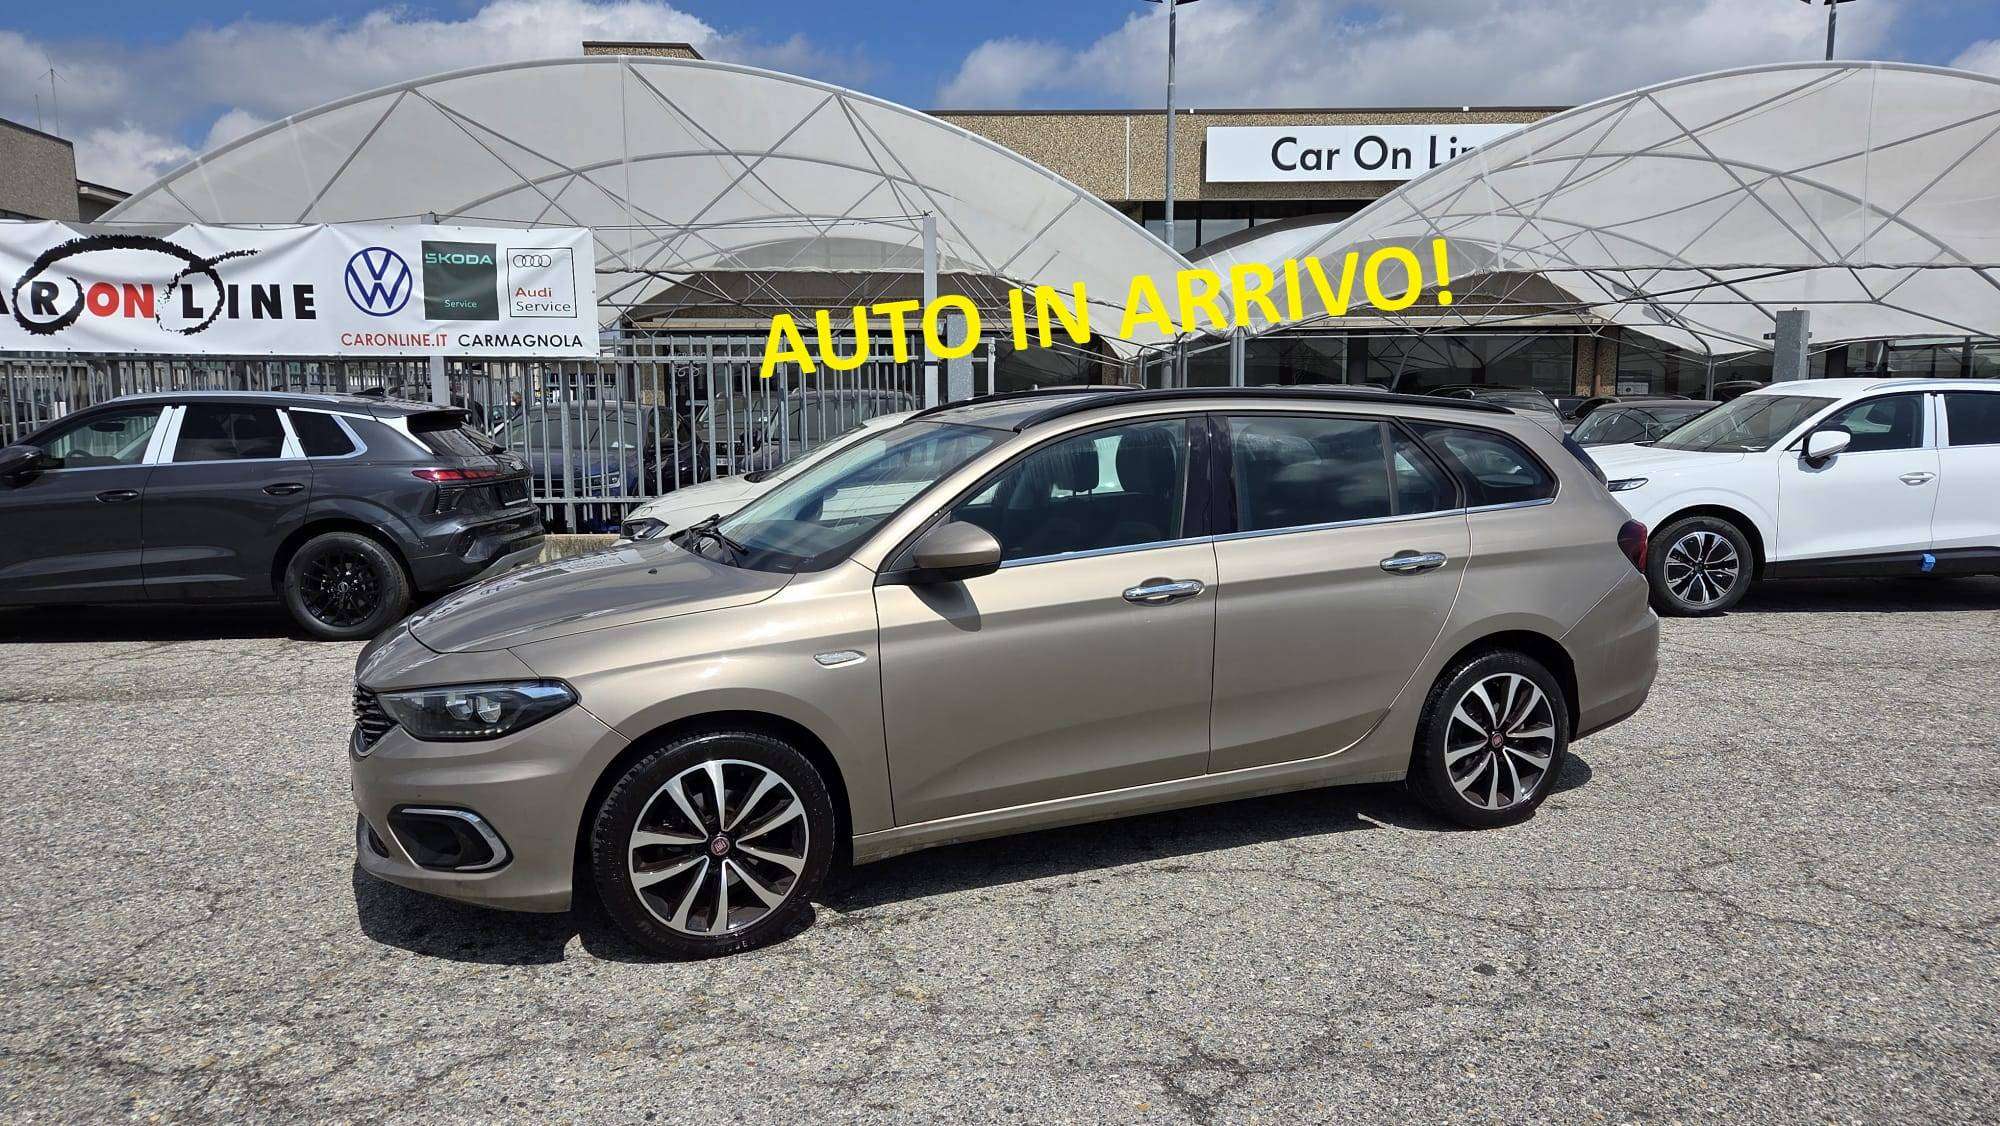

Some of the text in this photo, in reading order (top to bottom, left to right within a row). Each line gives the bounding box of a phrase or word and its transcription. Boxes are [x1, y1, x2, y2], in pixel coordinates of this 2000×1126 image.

[1271, 134, 1475, 171] Car On Li
[515, 287, 553, 298] Audi
[444, 299, 478, 309] Service
[516, 301, 572, 313] Service
[341, 333, 583, 348] CARONLINE.IT CARMAGNOLA
